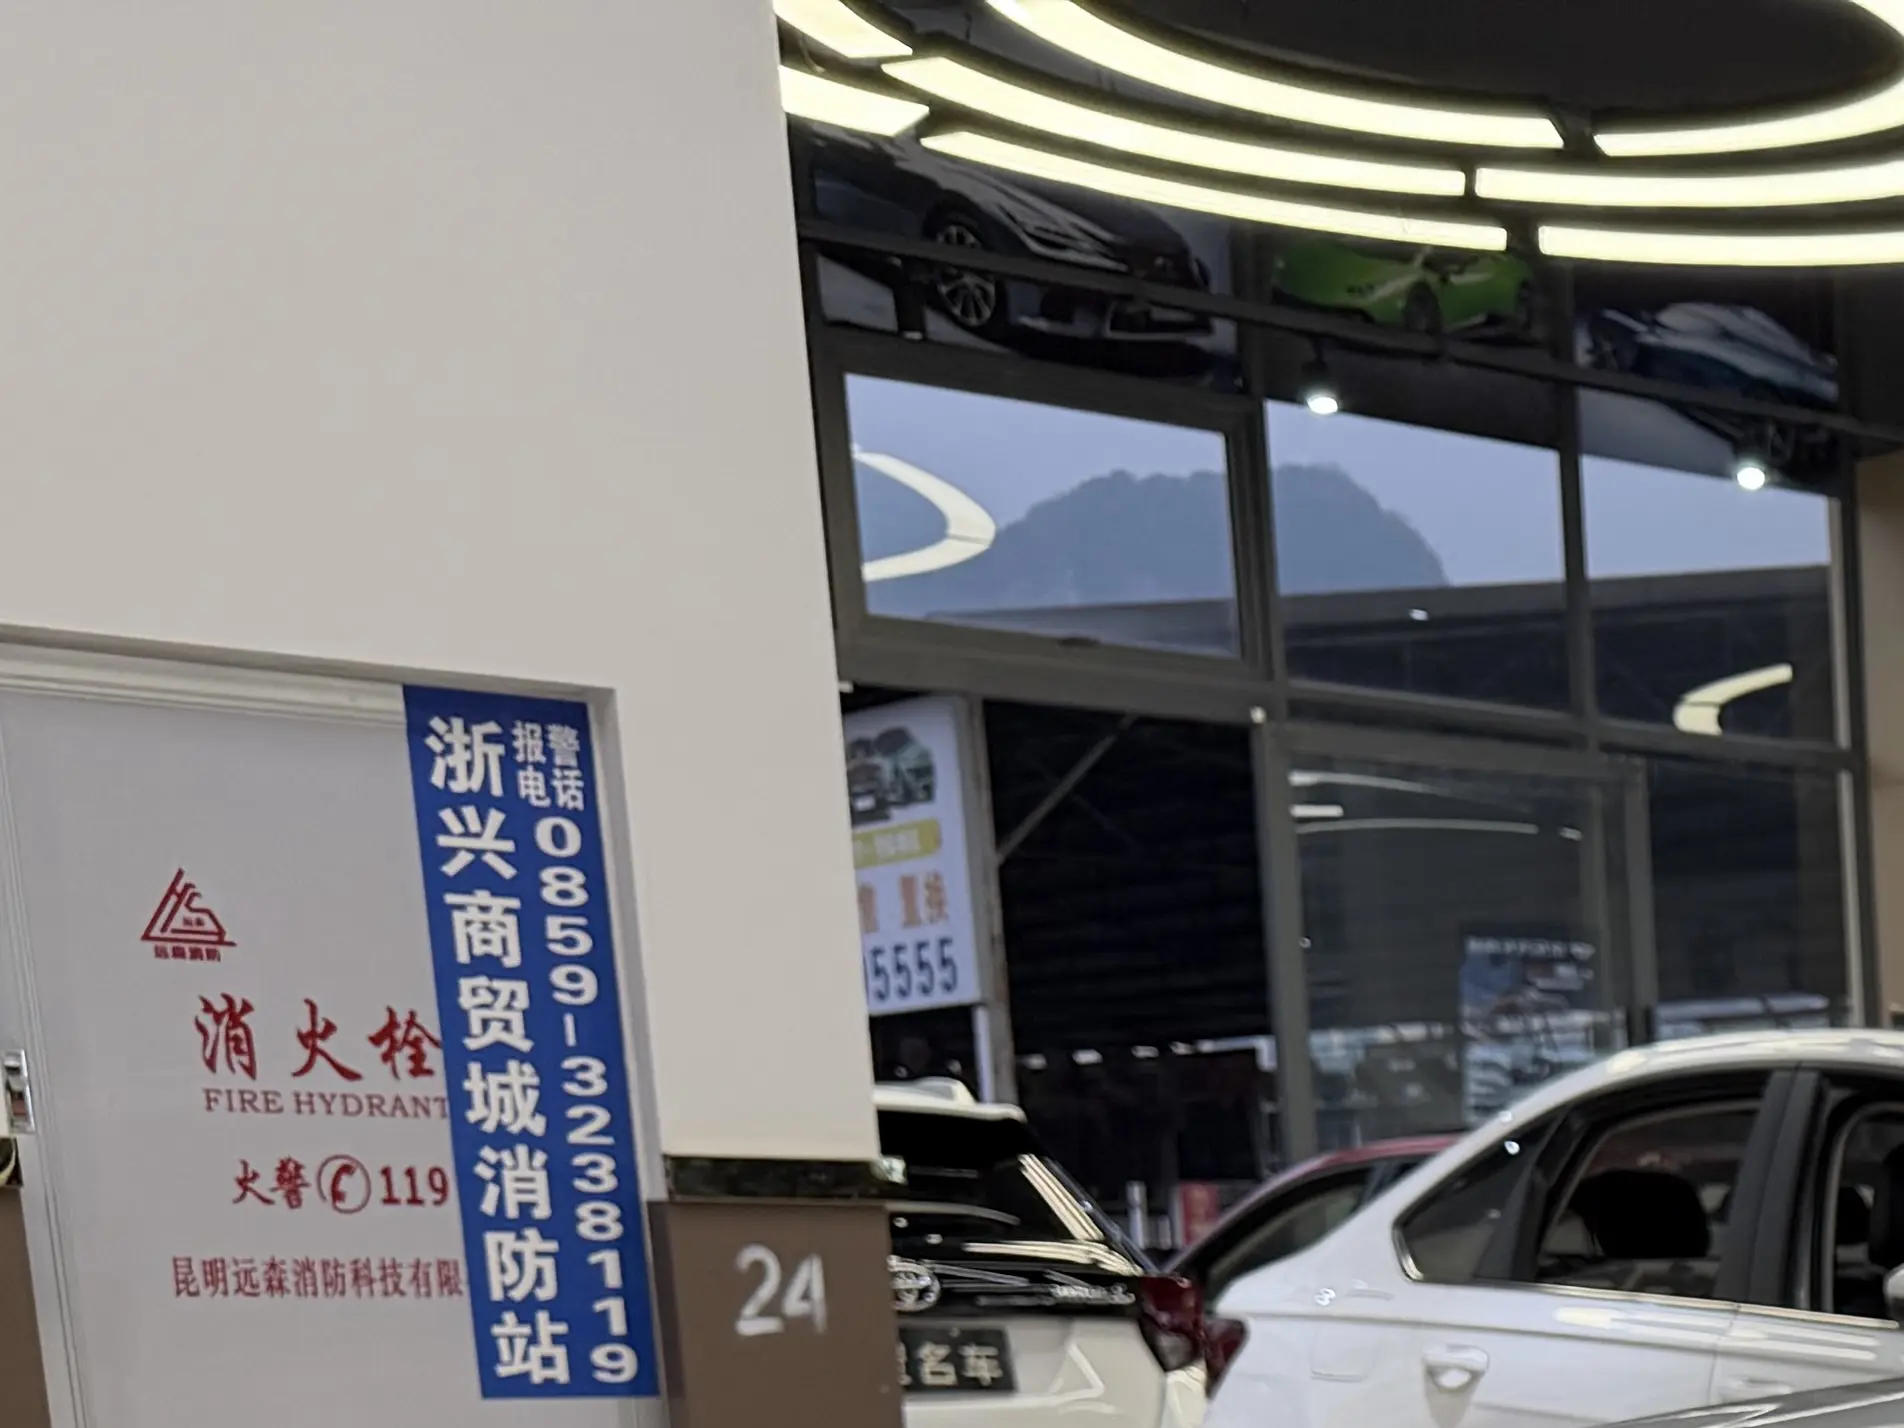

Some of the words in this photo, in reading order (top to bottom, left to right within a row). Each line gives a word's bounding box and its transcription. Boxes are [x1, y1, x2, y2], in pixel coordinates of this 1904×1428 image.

[194, 992, 442, 1082] 消火栓
[425, 716, 571, 1385] 浙兴商贸城消防站
[201, 1087, 284, 1115] FIRE
[293, 1091, 450, 1120] HYDRANT
[231, 1154, 311, 1210] 火警
[379, 1165, 449, 1206] 119
[171, 1254, 464, 1299] 昆明远森消防科技有限
[734, 1242, 828, 1337] 24
